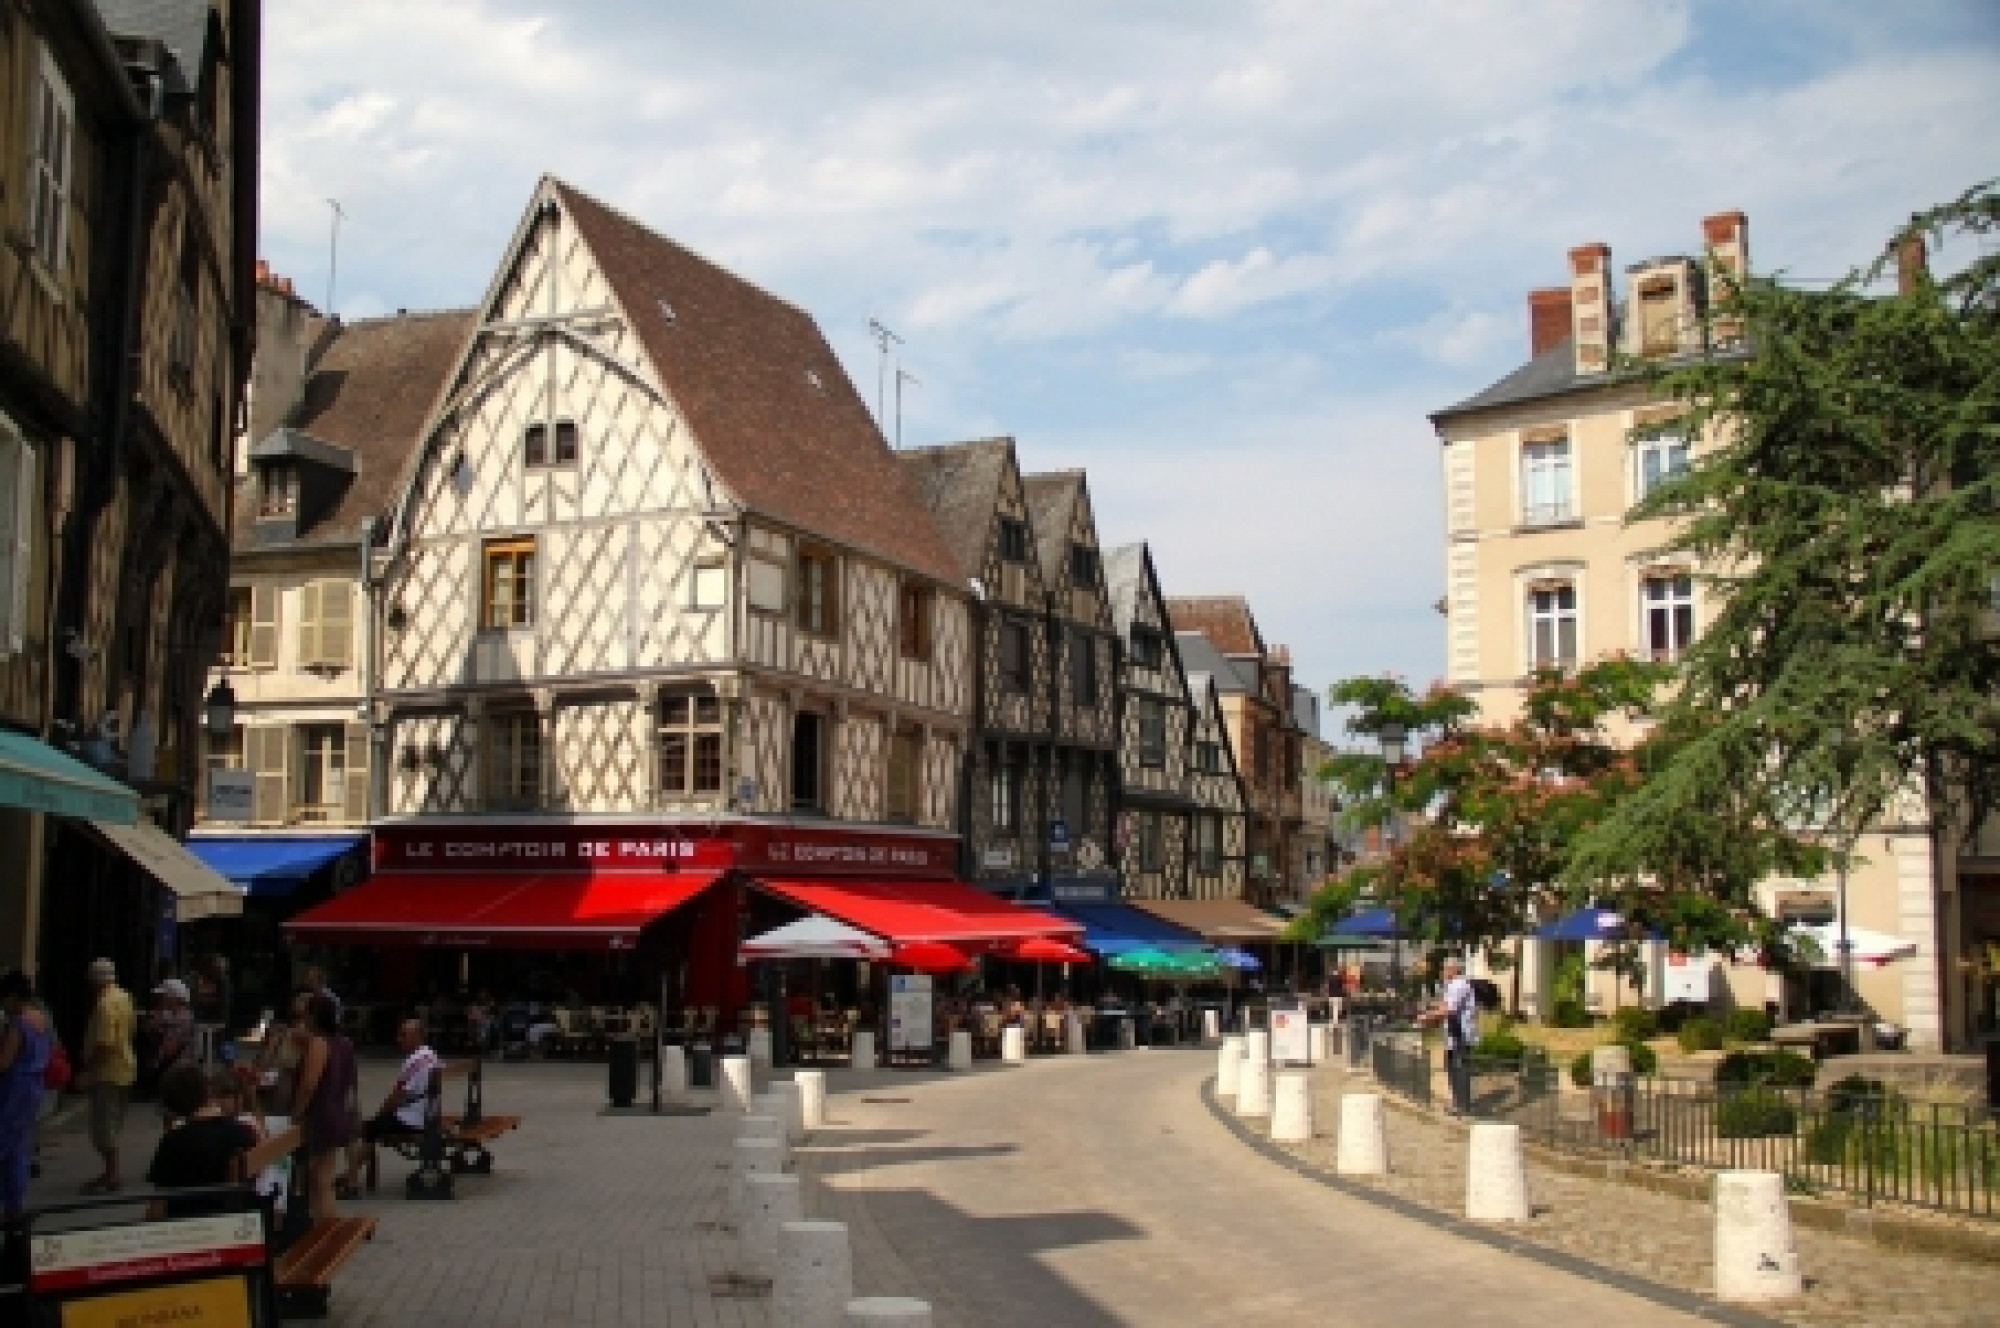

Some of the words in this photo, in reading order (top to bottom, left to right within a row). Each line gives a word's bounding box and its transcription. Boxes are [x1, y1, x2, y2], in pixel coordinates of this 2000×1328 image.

[405, 842, 433, 856] LE
[445, 842, 566, 856] COMPTOIR
[578, 841, 610, 856] DE
[617, 840, 695, 856] PARIS
